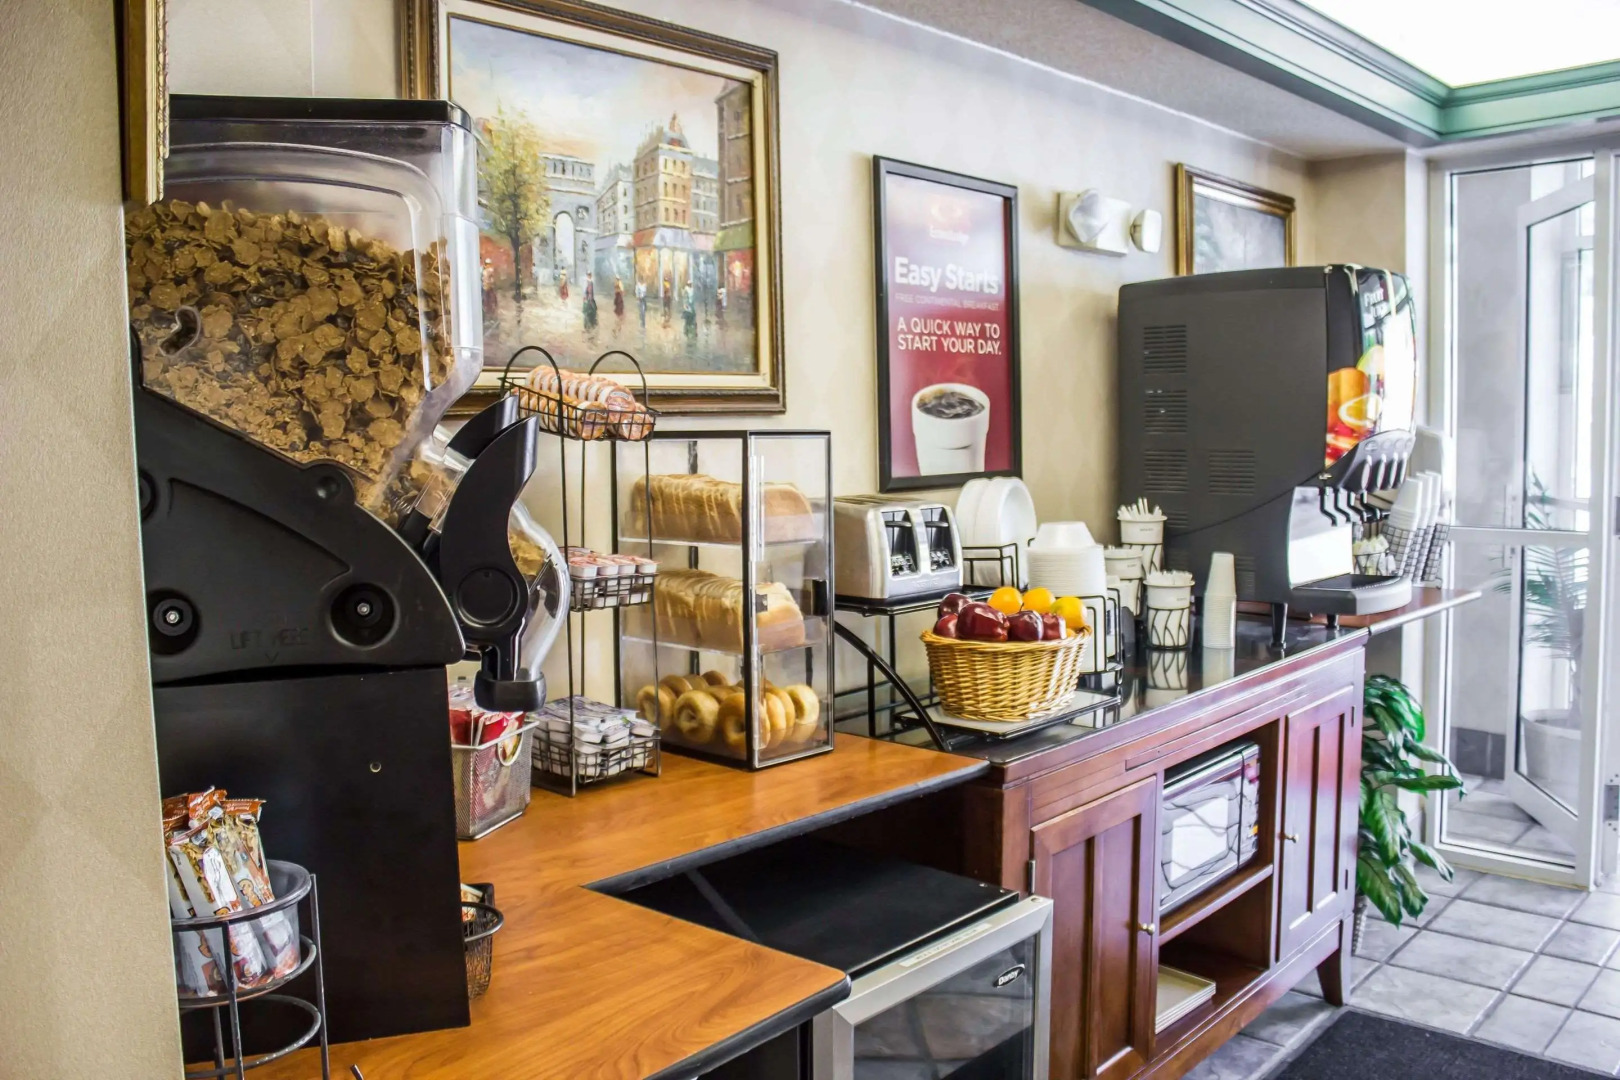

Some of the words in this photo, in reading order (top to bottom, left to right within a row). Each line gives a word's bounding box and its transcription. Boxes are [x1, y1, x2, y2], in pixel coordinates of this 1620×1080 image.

[894, 256, 942, 293] Easy
[944, 263, 999, 294] Starts
[897, 317, 907, 332] A
[910, 317, 951, 335] QUICK
[954, 321, 981, 337] WAY
[984, 323, 1001, 339] TO
[898, 334, 938, 352] START
[941, 337, 975, 353] YOUR
[977, 339, 1002, 355] DAY.
